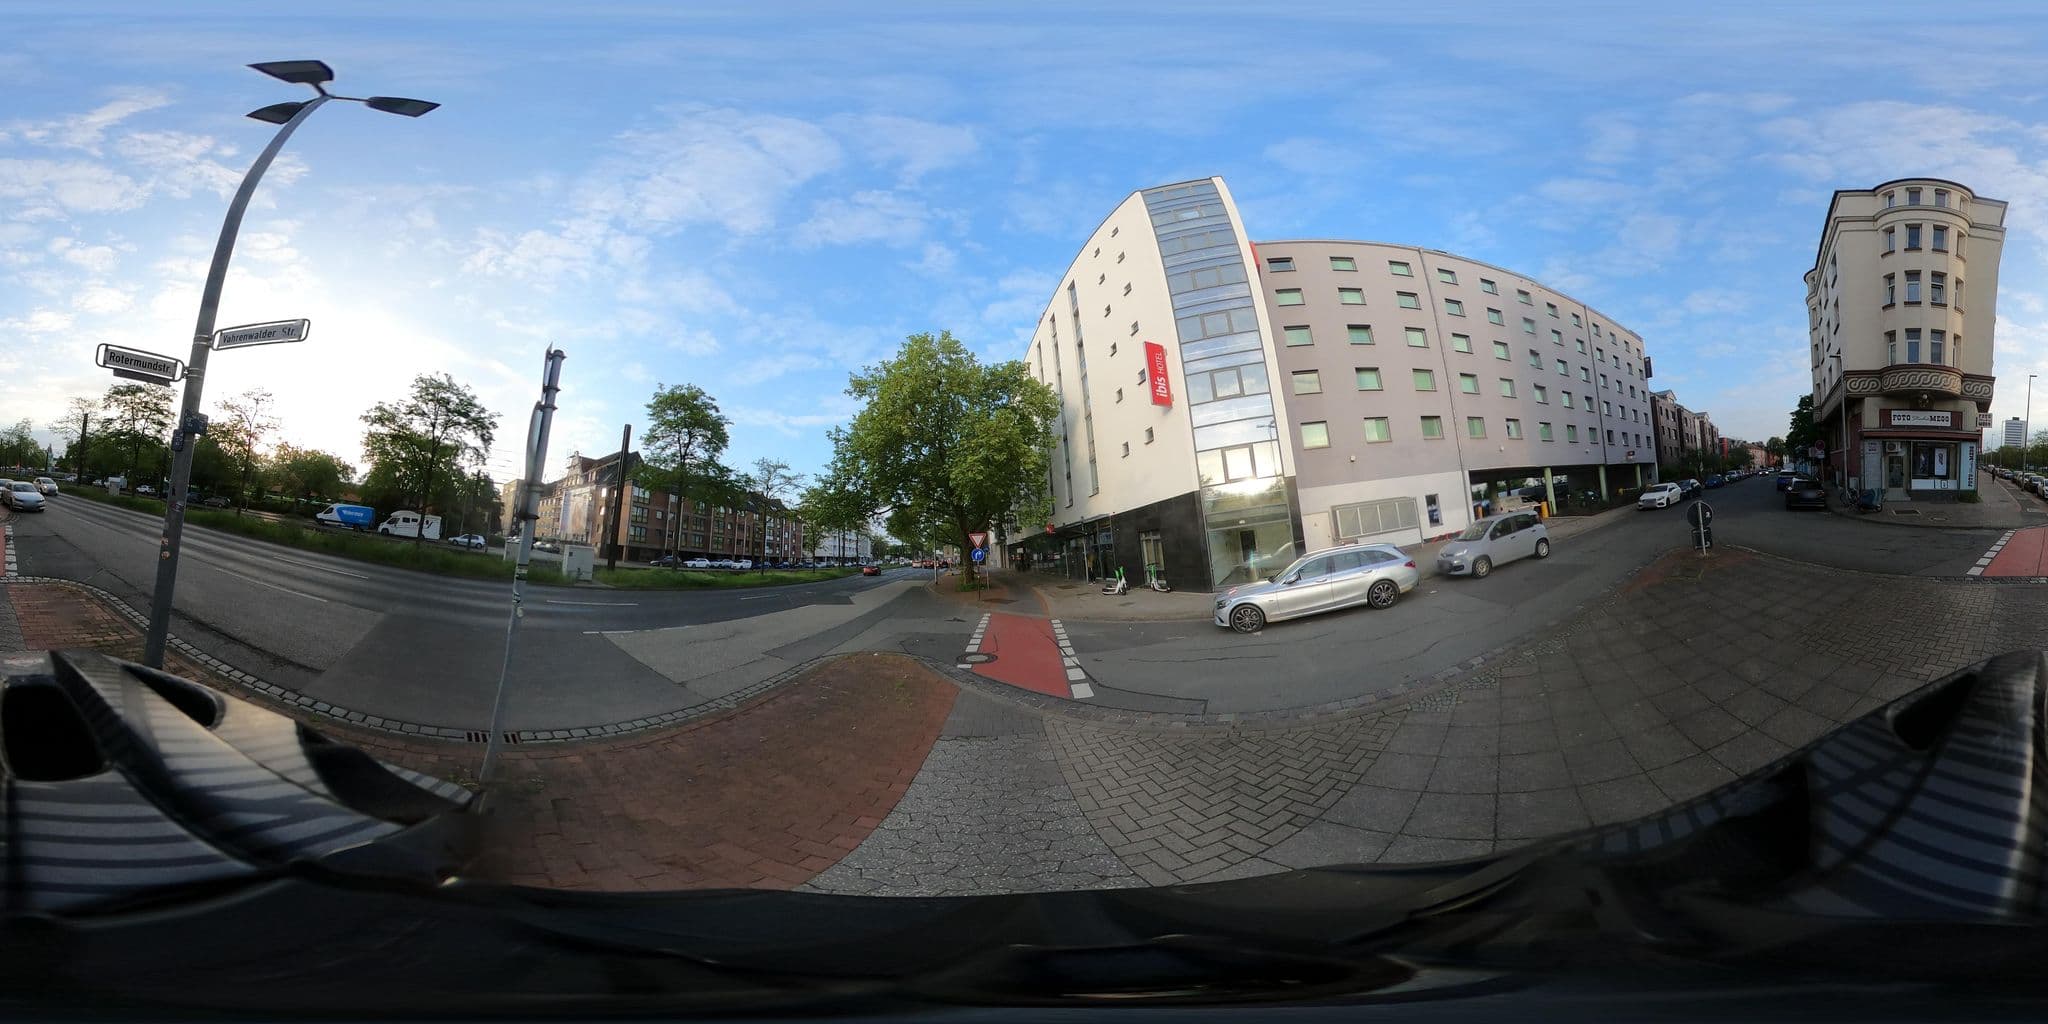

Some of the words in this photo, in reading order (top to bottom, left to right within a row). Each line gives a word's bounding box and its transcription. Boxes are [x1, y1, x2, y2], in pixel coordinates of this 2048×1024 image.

[222, 329, 277, 343] Vahrenwalder
[282, 326, 296, 337] Str.
[109, 351, 171, 374] Rotermundstr.
[1155, 352, 1165, 374] HOTEL
[1154, 376, 1168, 398] ibis
